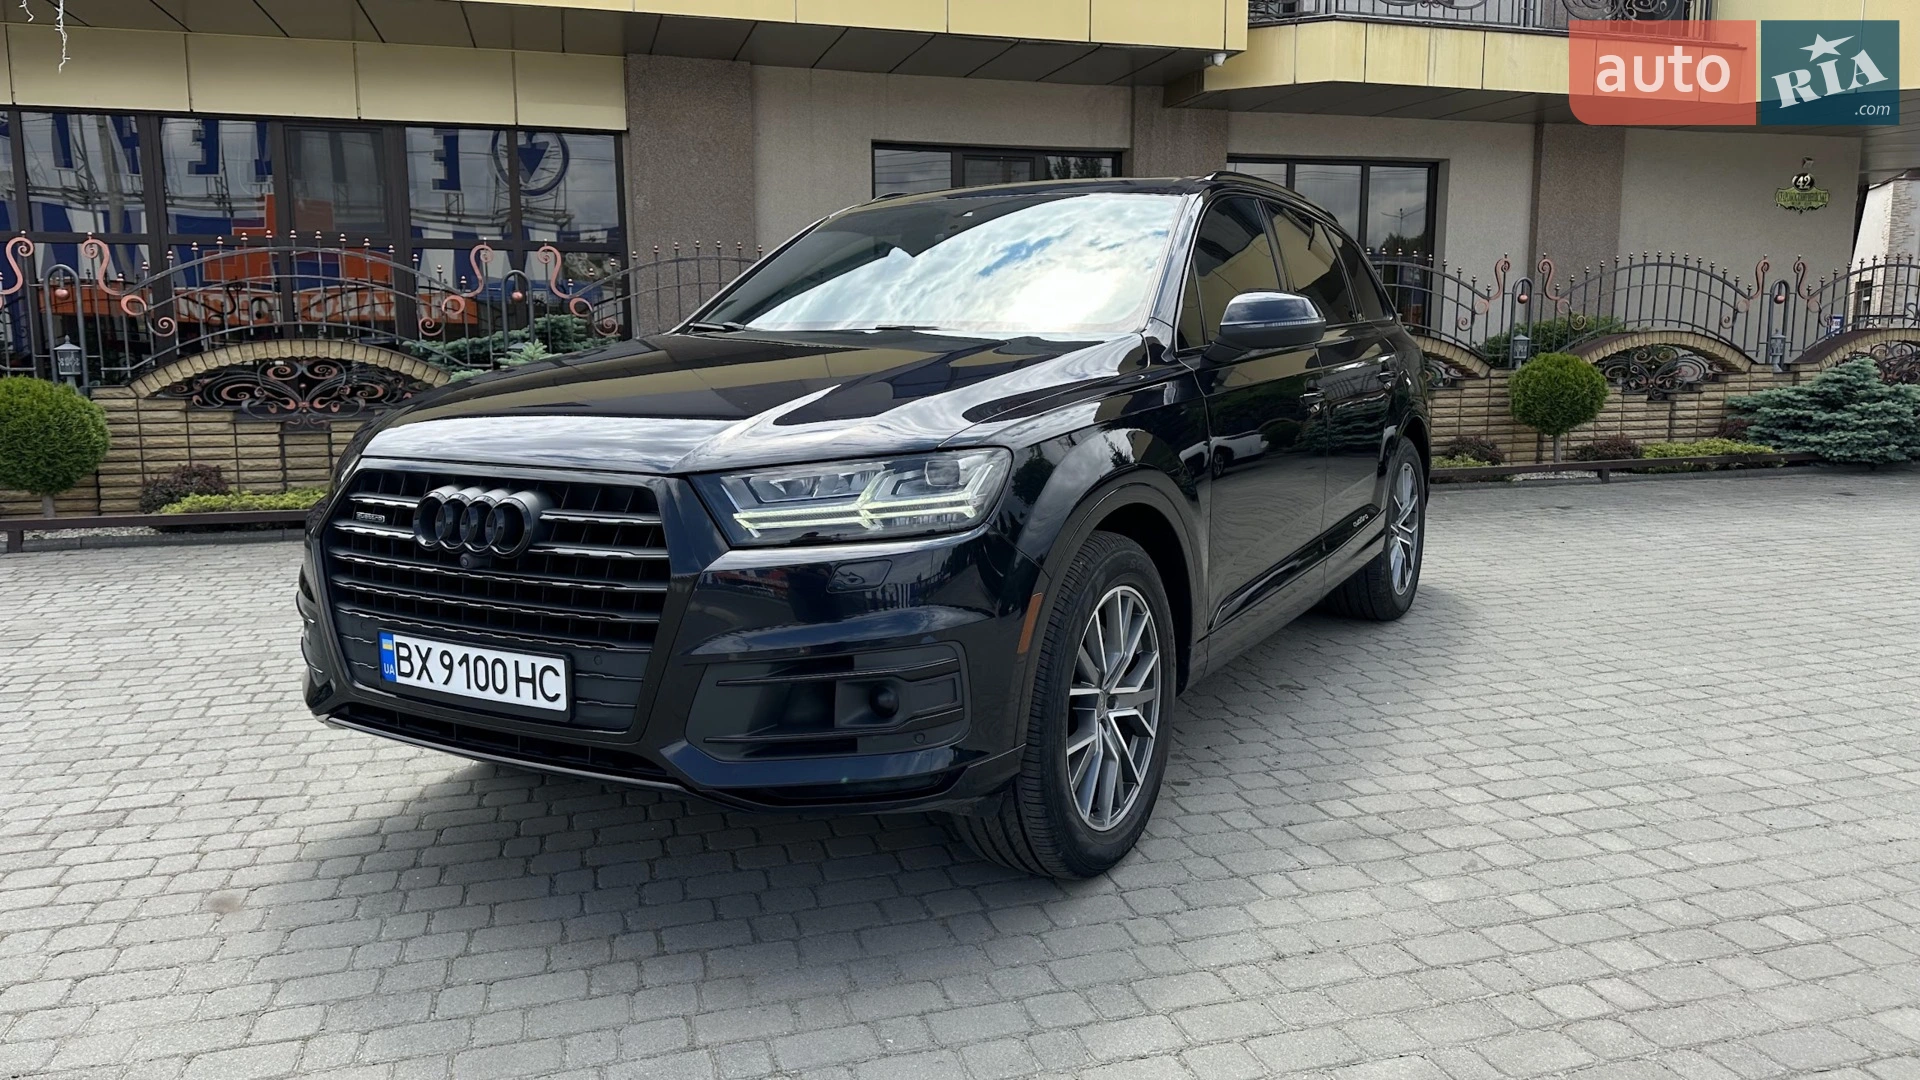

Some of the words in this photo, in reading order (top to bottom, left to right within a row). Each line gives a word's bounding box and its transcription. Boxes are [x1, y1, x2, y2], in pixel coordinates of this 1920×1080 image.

[1796, 175, 1811, 189] 42
[383, 663, 396, 676] UA
[395, 641, 435, 684] BX
[439, 649, 508, 695] 9100
[514, 659, 562, 703] HC
